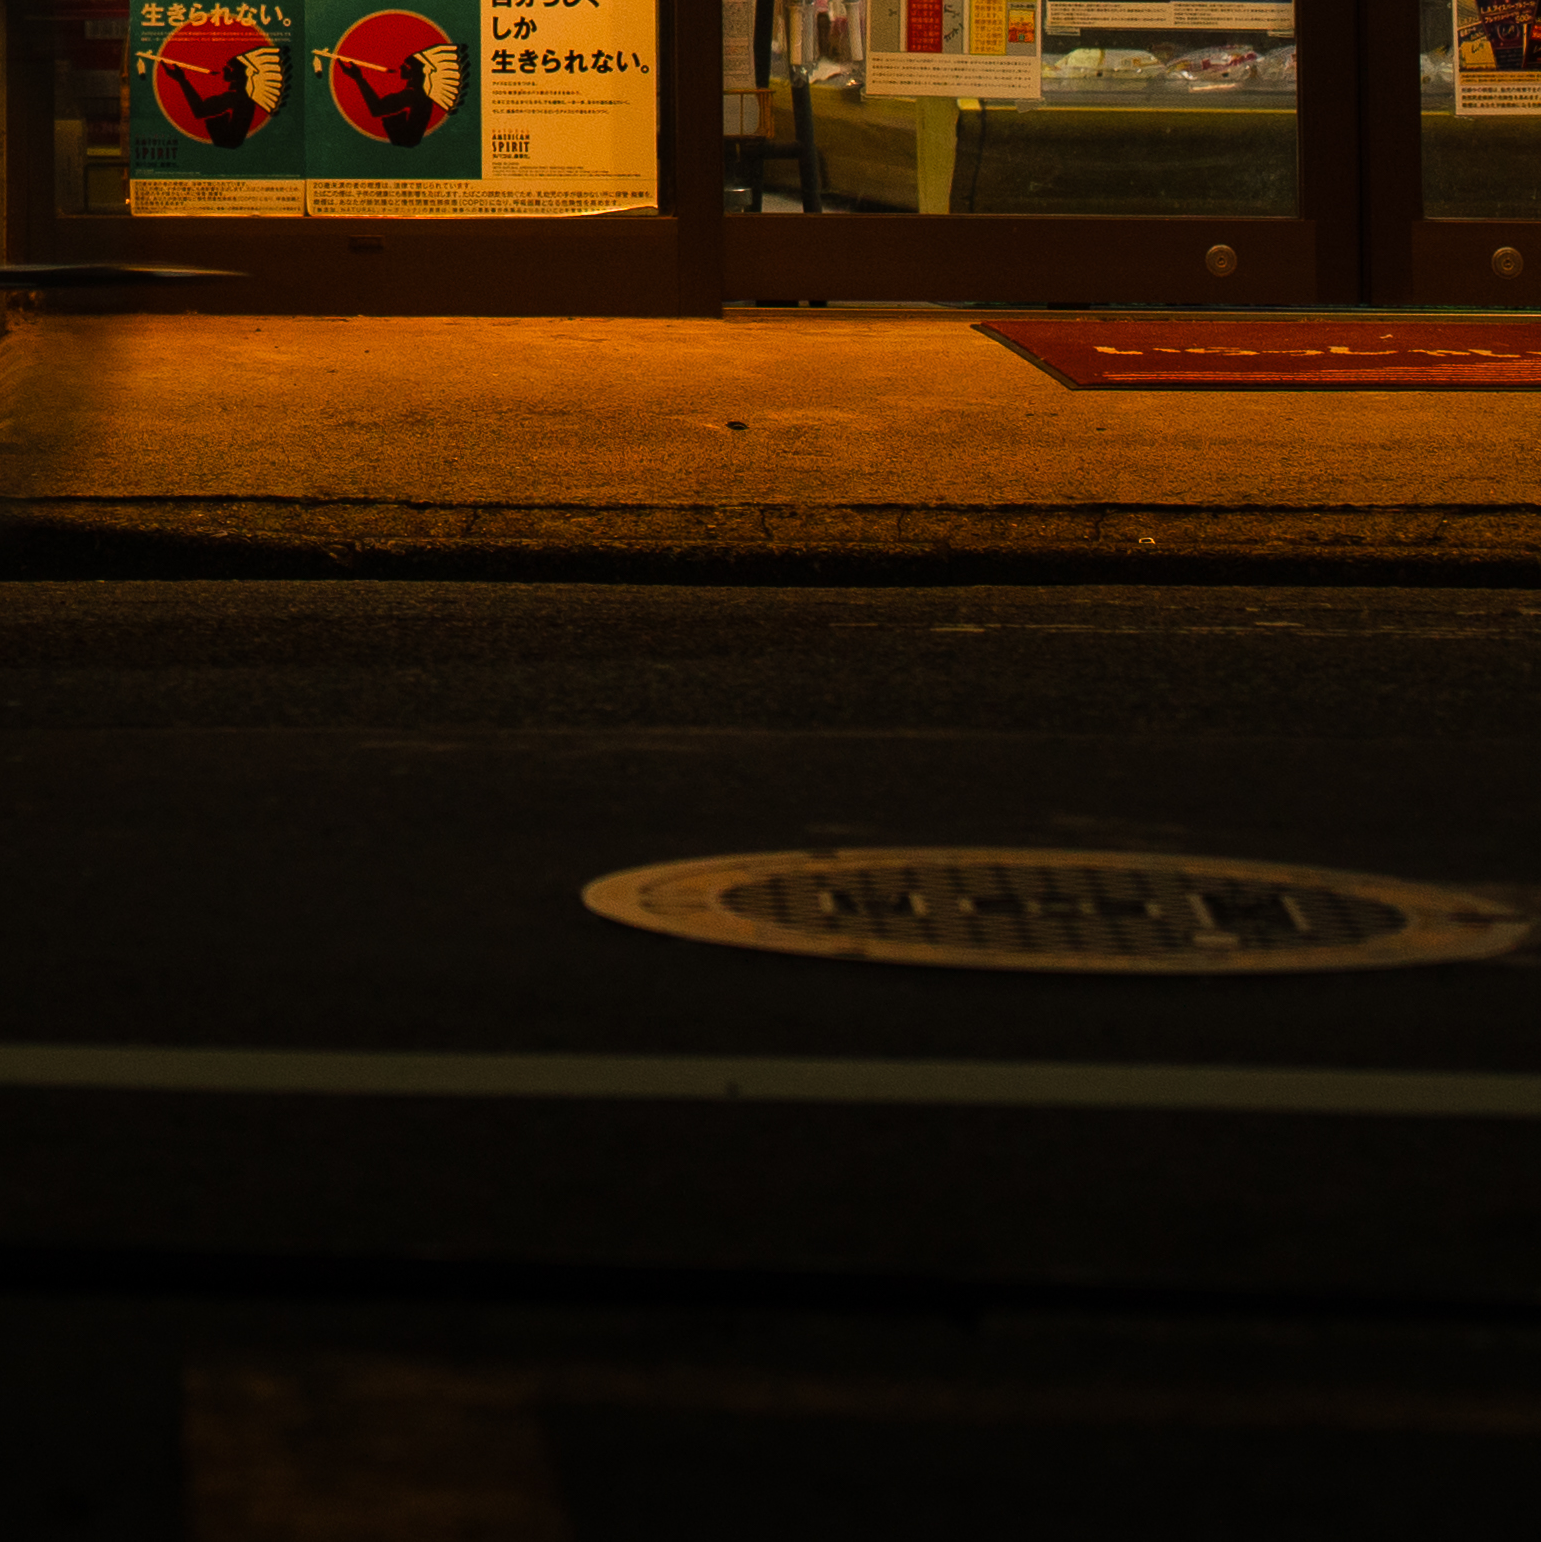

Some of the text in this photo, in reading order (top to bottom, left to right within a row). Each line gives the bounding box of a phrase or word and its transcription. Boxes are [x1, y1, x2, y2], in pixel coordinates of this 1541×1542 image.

[141, 2, 292, 27] 生きられない。
[492, 17, 537, 39] しか
[490, 48, 650, 74] 生きられない。
